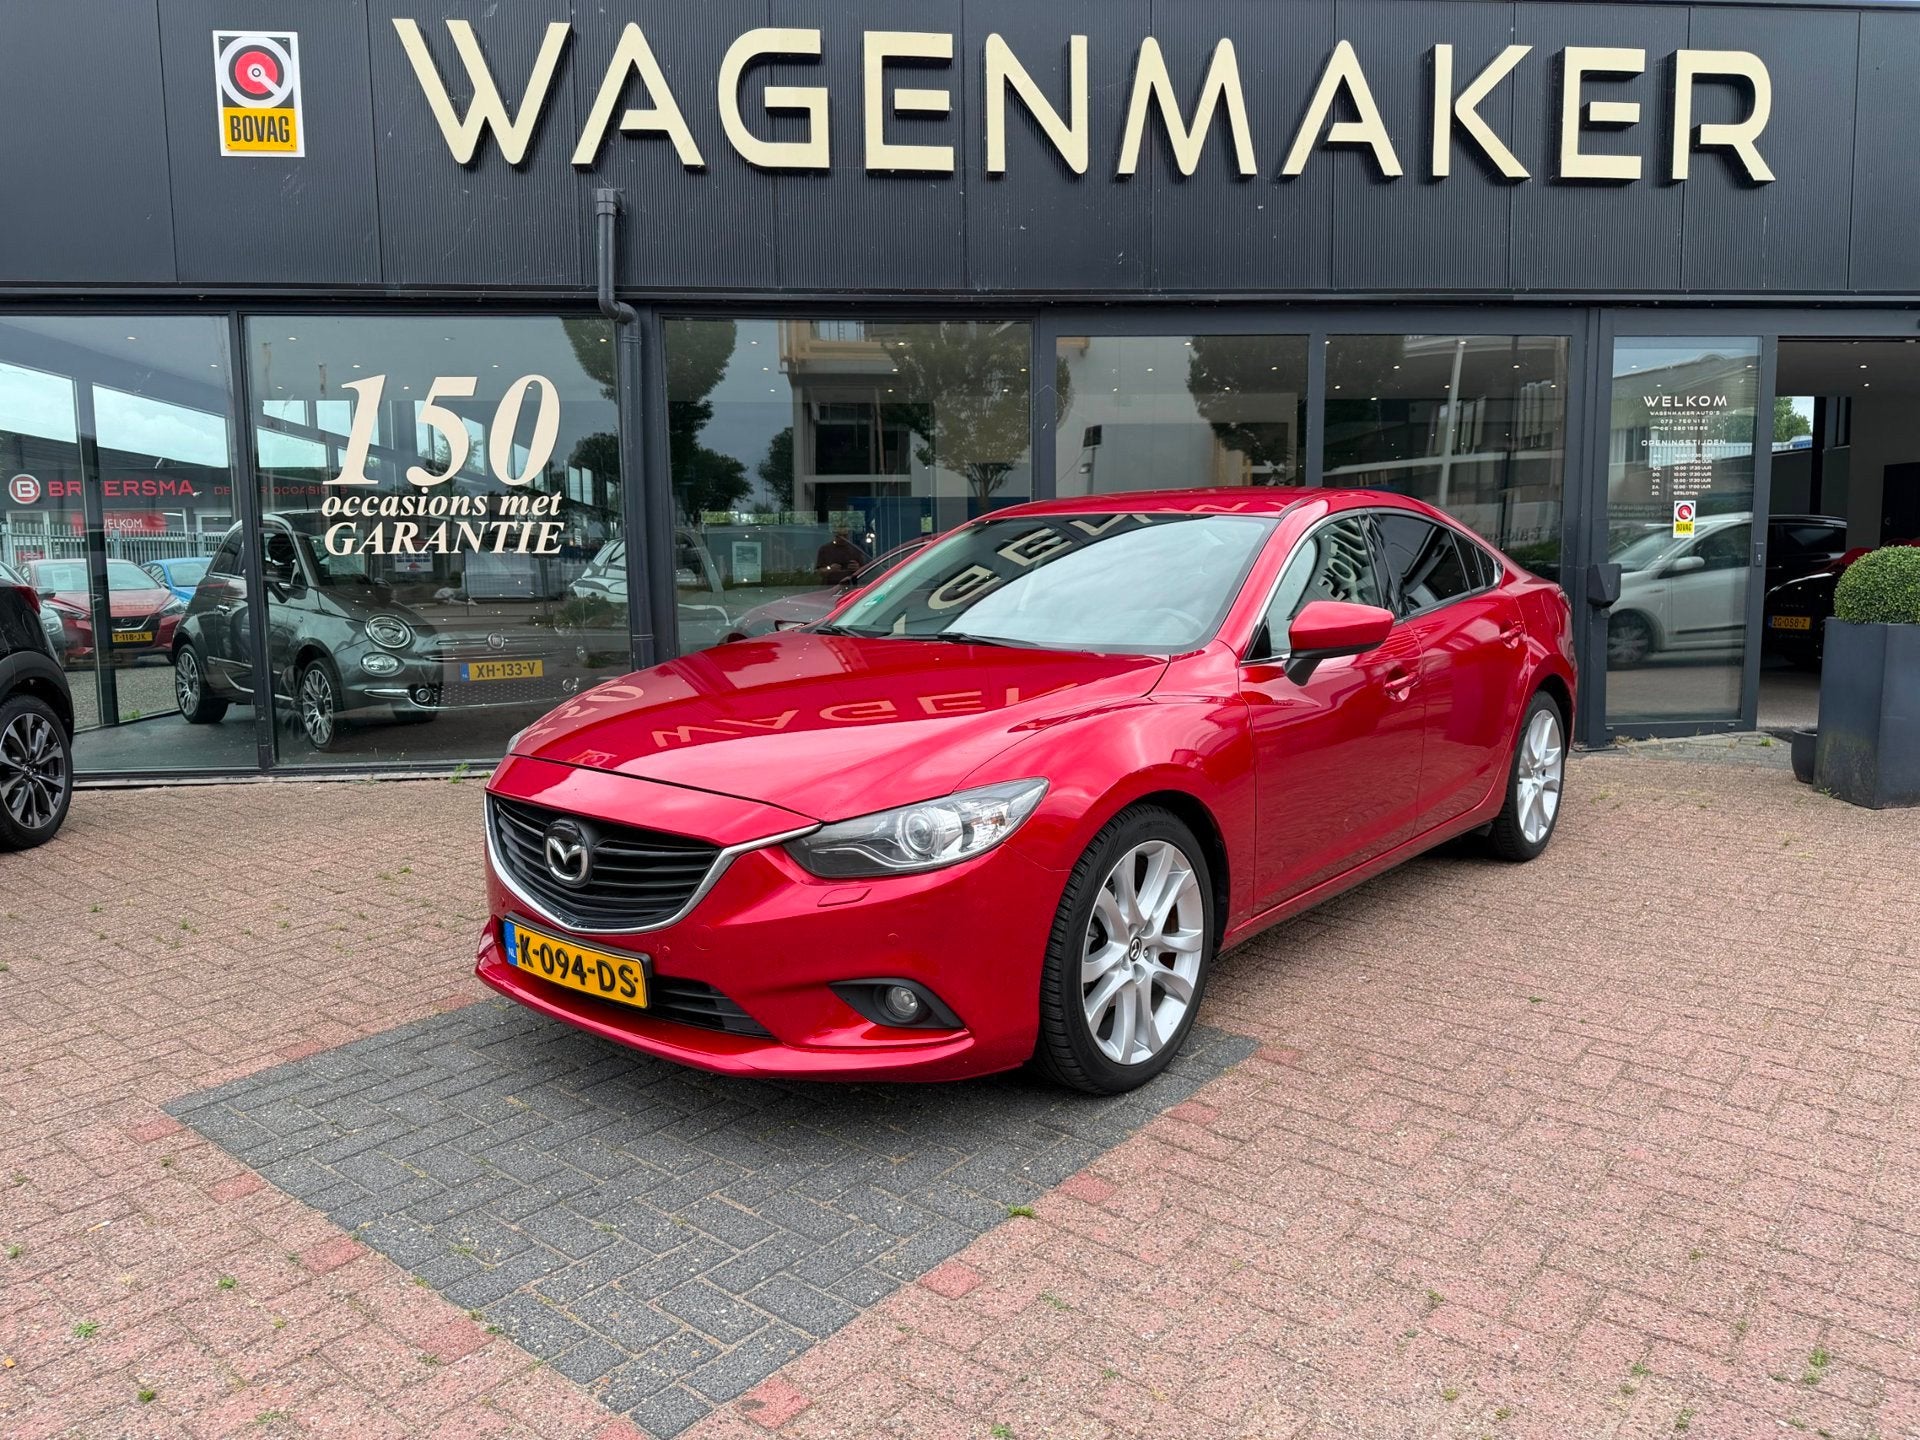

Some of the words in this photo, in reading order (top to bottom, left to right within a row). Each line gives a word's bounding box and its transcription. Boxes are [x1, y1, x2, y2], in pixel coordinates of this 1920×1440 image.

[392, 18, 1775, 182] WAGENMAKER
[229, 115, 290, 144] BOVAG
[1643, 395, 1728, 407] WELKOM
[322, 374, 560, 486] 150
[48, 479, 194, 497] BRERSMA
[321, 486, 488, 518] occasions
[499, 490, 563, 517] met
[324, 520, 565, 556] GARANTIE
[1675, 523, 1692, 532] BOVAG
[475, 661, 536, 679] XH-133-V
[518, 932, 637, 998] K-094-DS
